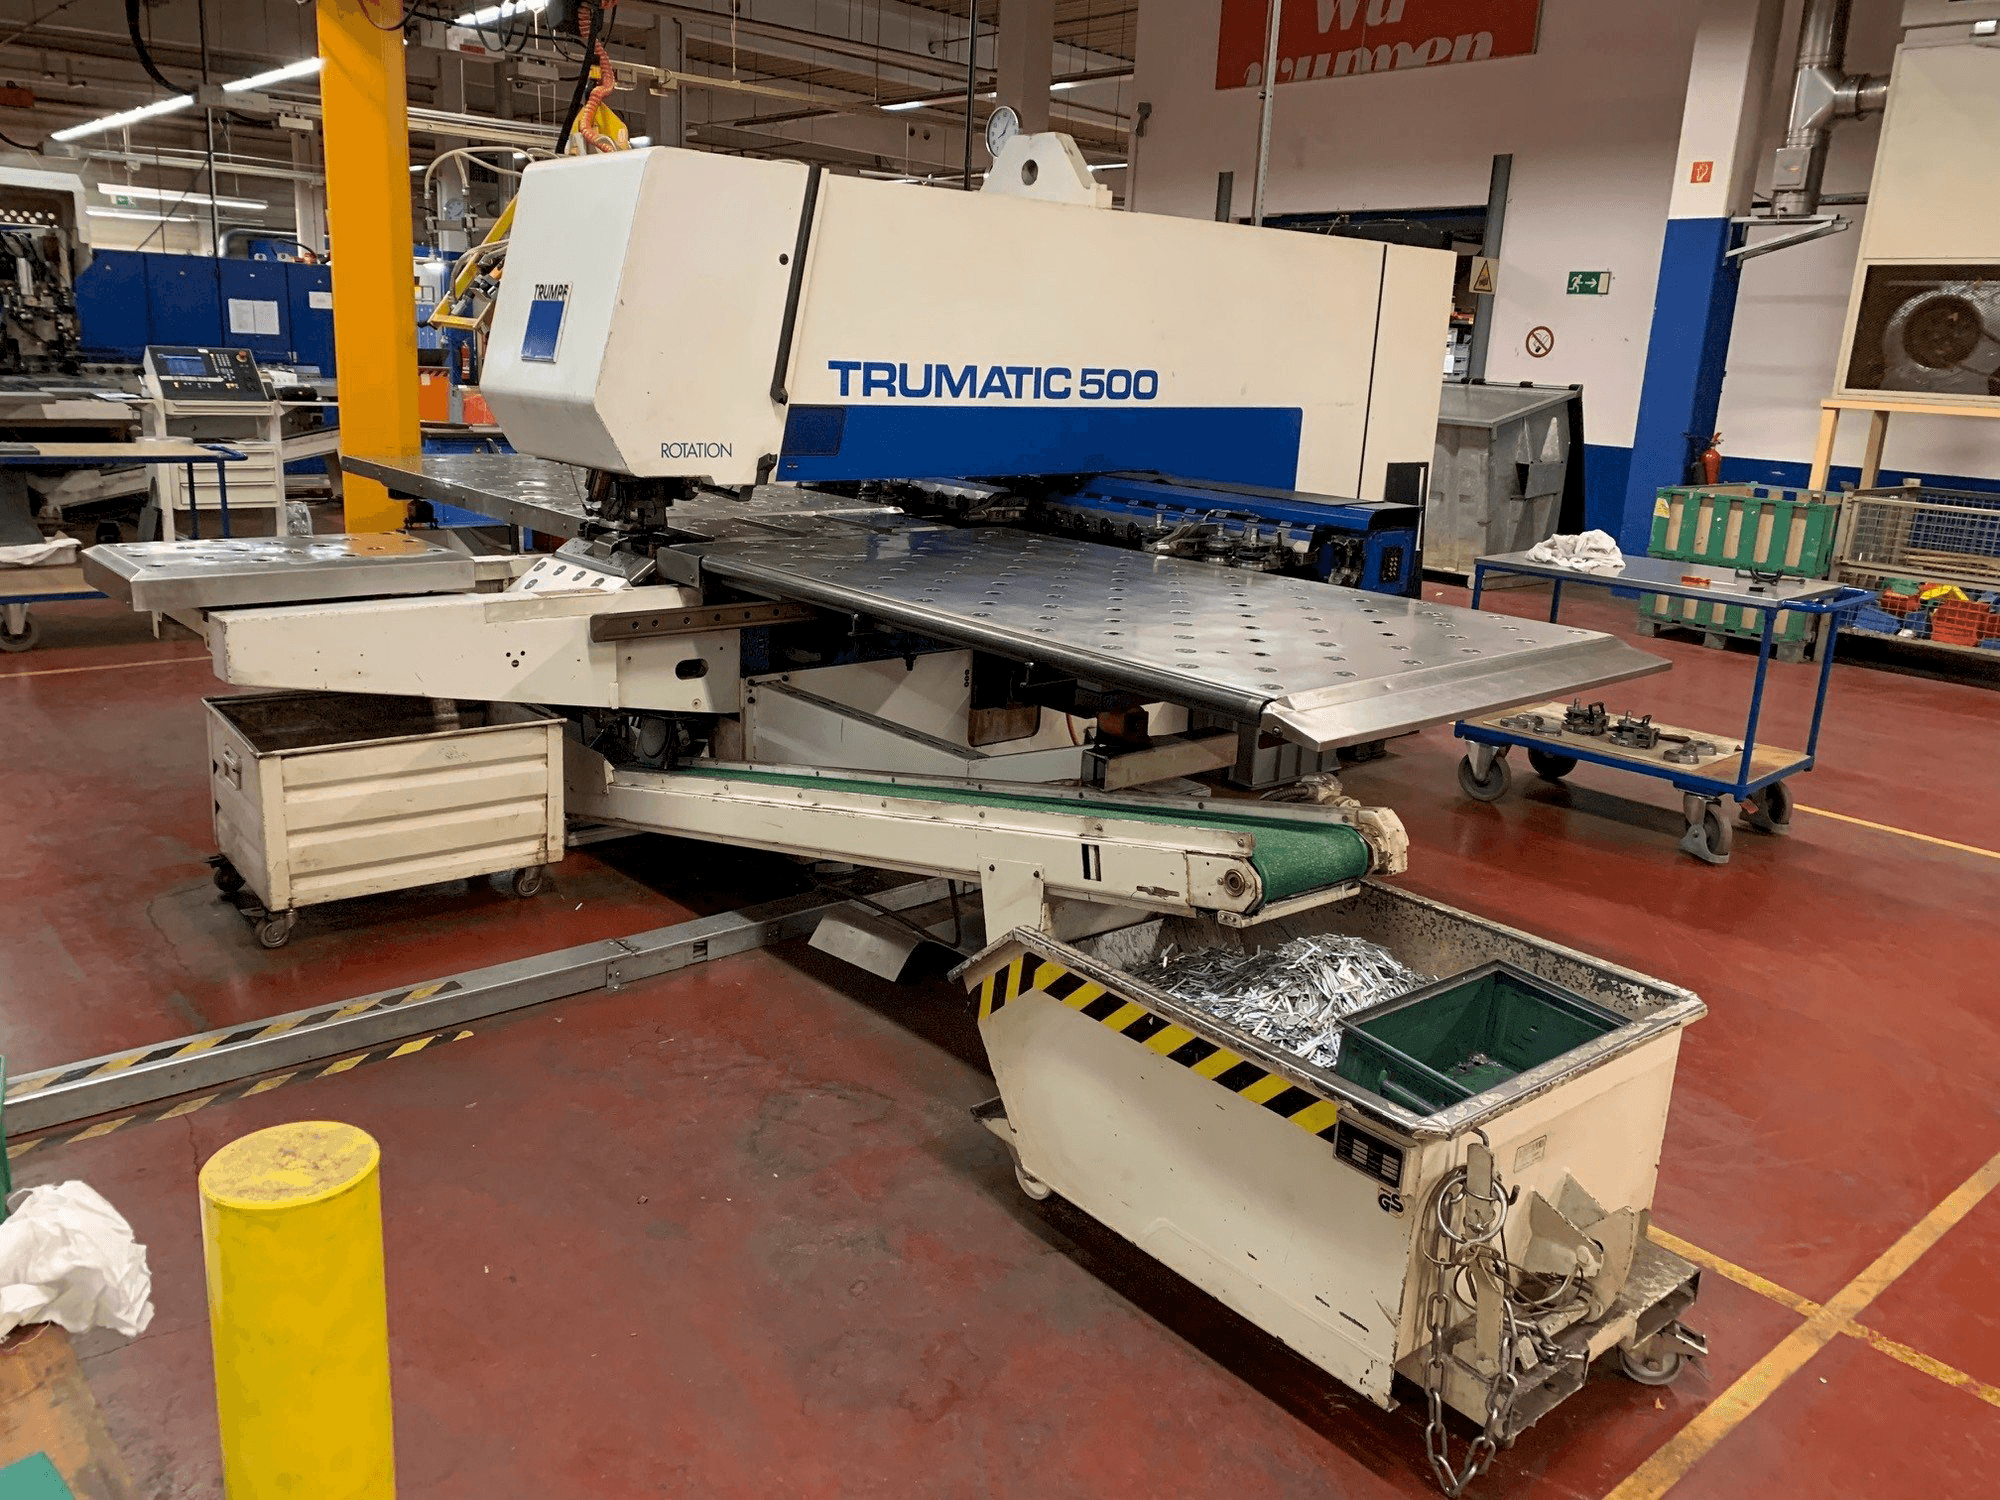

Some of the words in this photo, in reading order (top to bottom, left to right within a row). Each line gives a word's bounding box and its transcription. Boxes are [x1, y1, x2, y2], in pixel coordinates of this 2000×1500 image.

[534, 284, 569, 301] TRUMPF
[828, 360, 1072, 399] TRUMATIC
[1079, 368, 1159, 400] 500
[661, 442, 733, 458] ROTATION
[1378, 1193, 1404, 1213] GS
